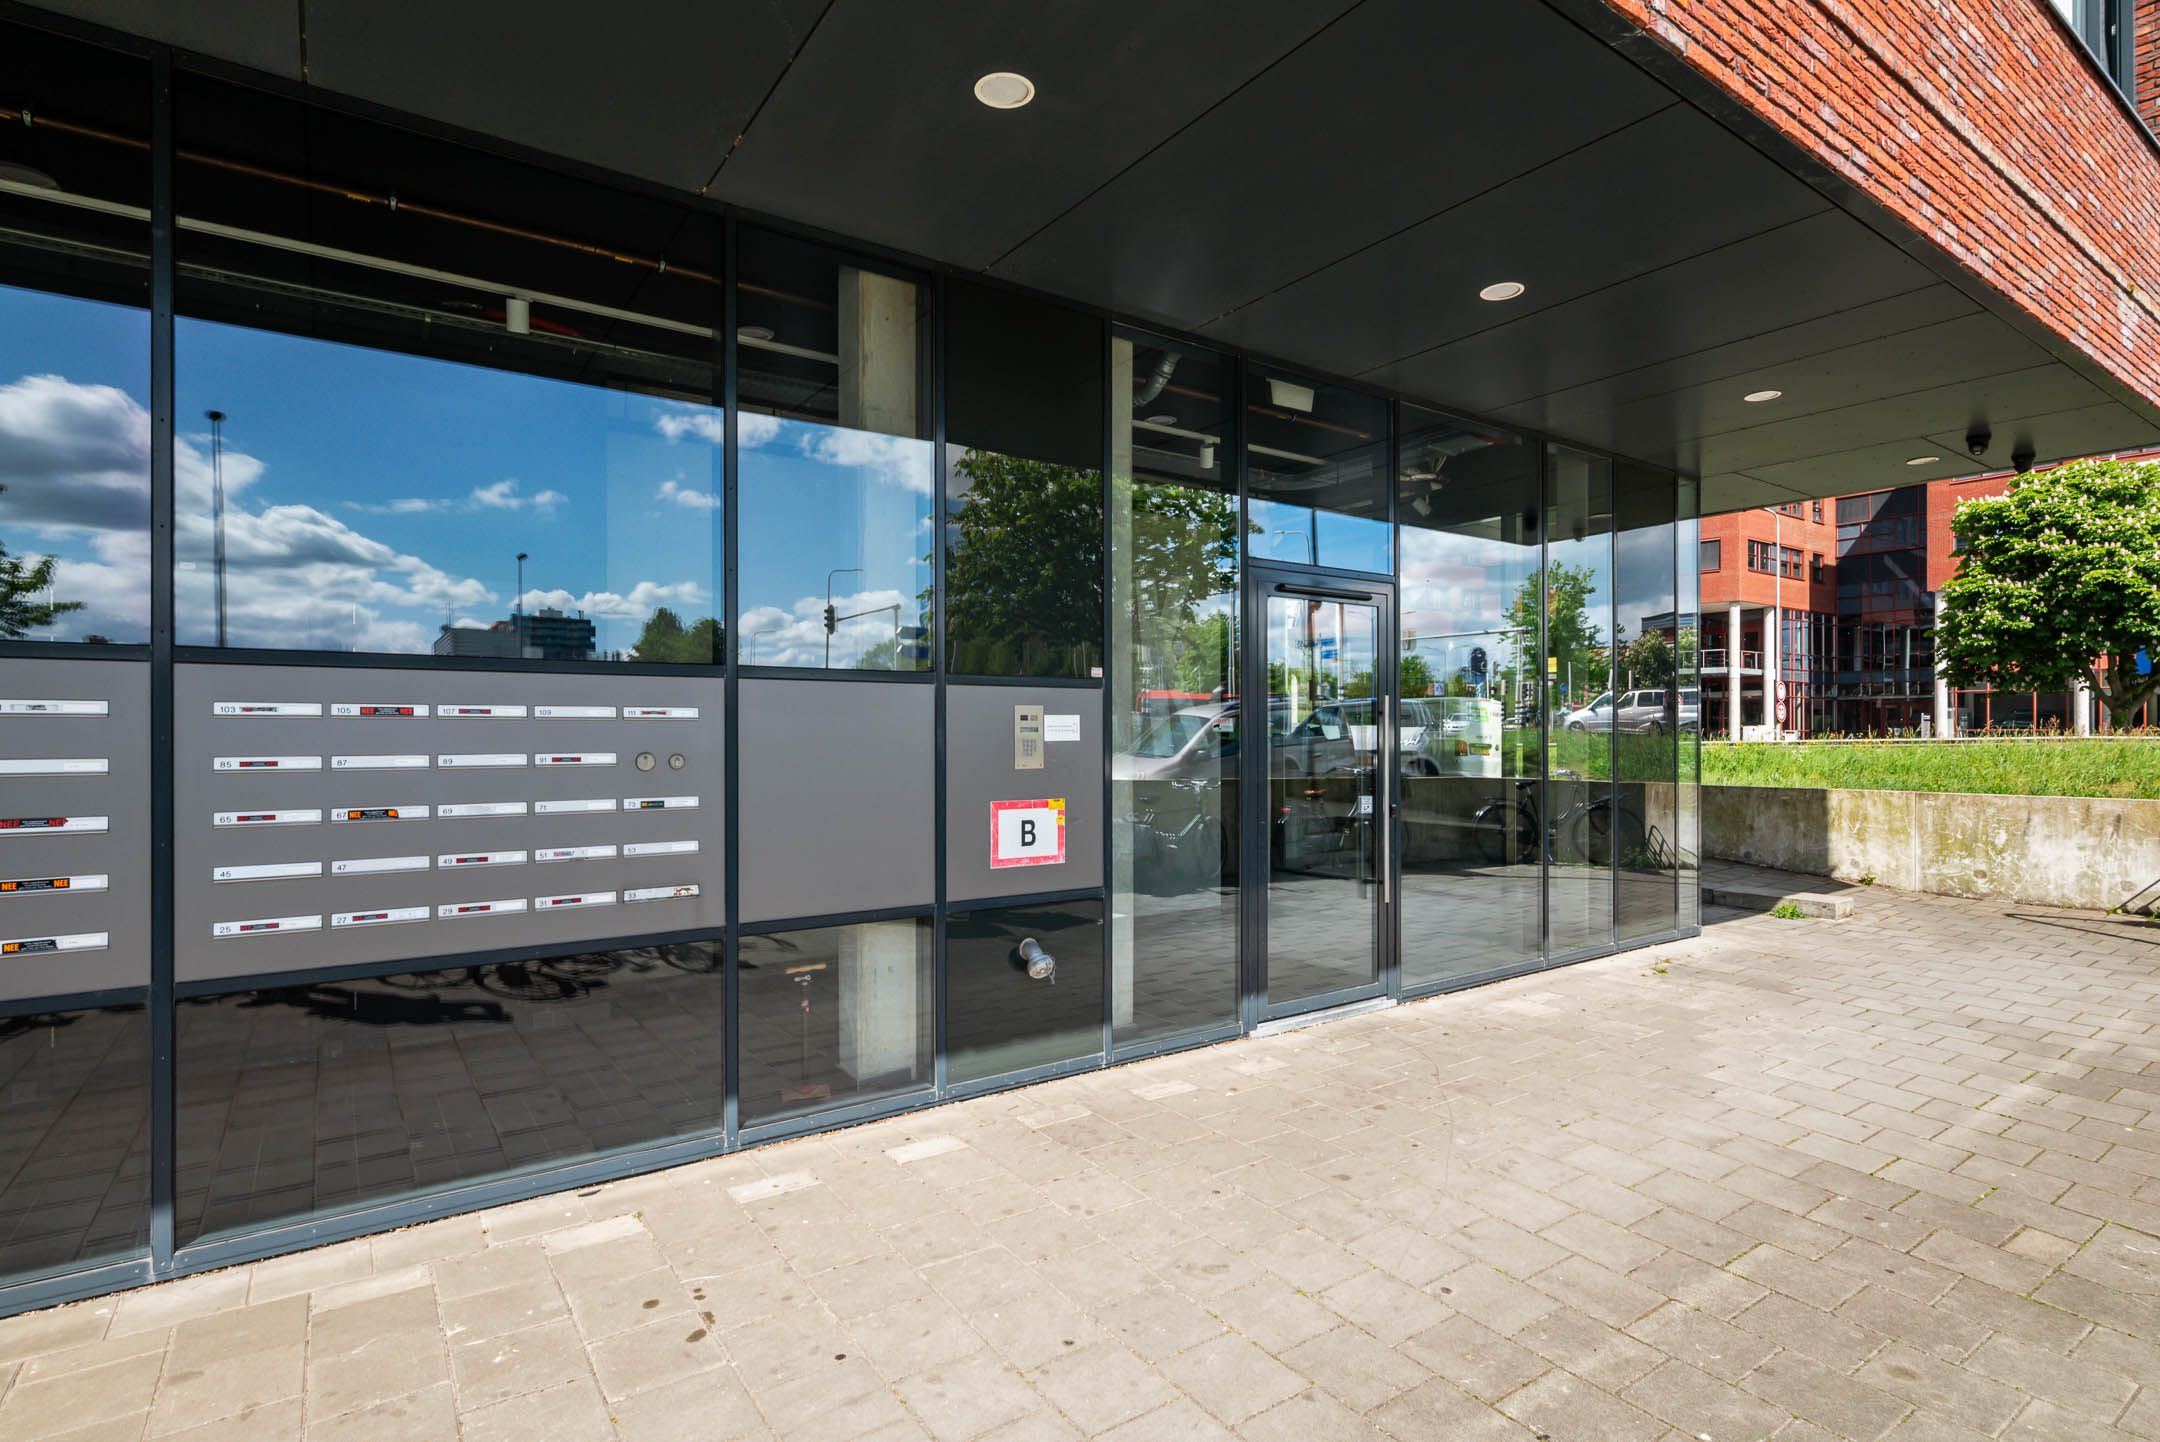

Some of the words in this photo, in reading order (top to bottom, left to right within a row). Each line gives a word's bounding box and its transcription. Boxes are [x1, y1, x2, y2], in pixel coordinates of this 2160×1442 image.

[1021, 820, 1036, 847] B
[2, 882, 16, 890] NEE
[54, 880, 68, 888] NEE
[4, 944, 20, 952] NEE
